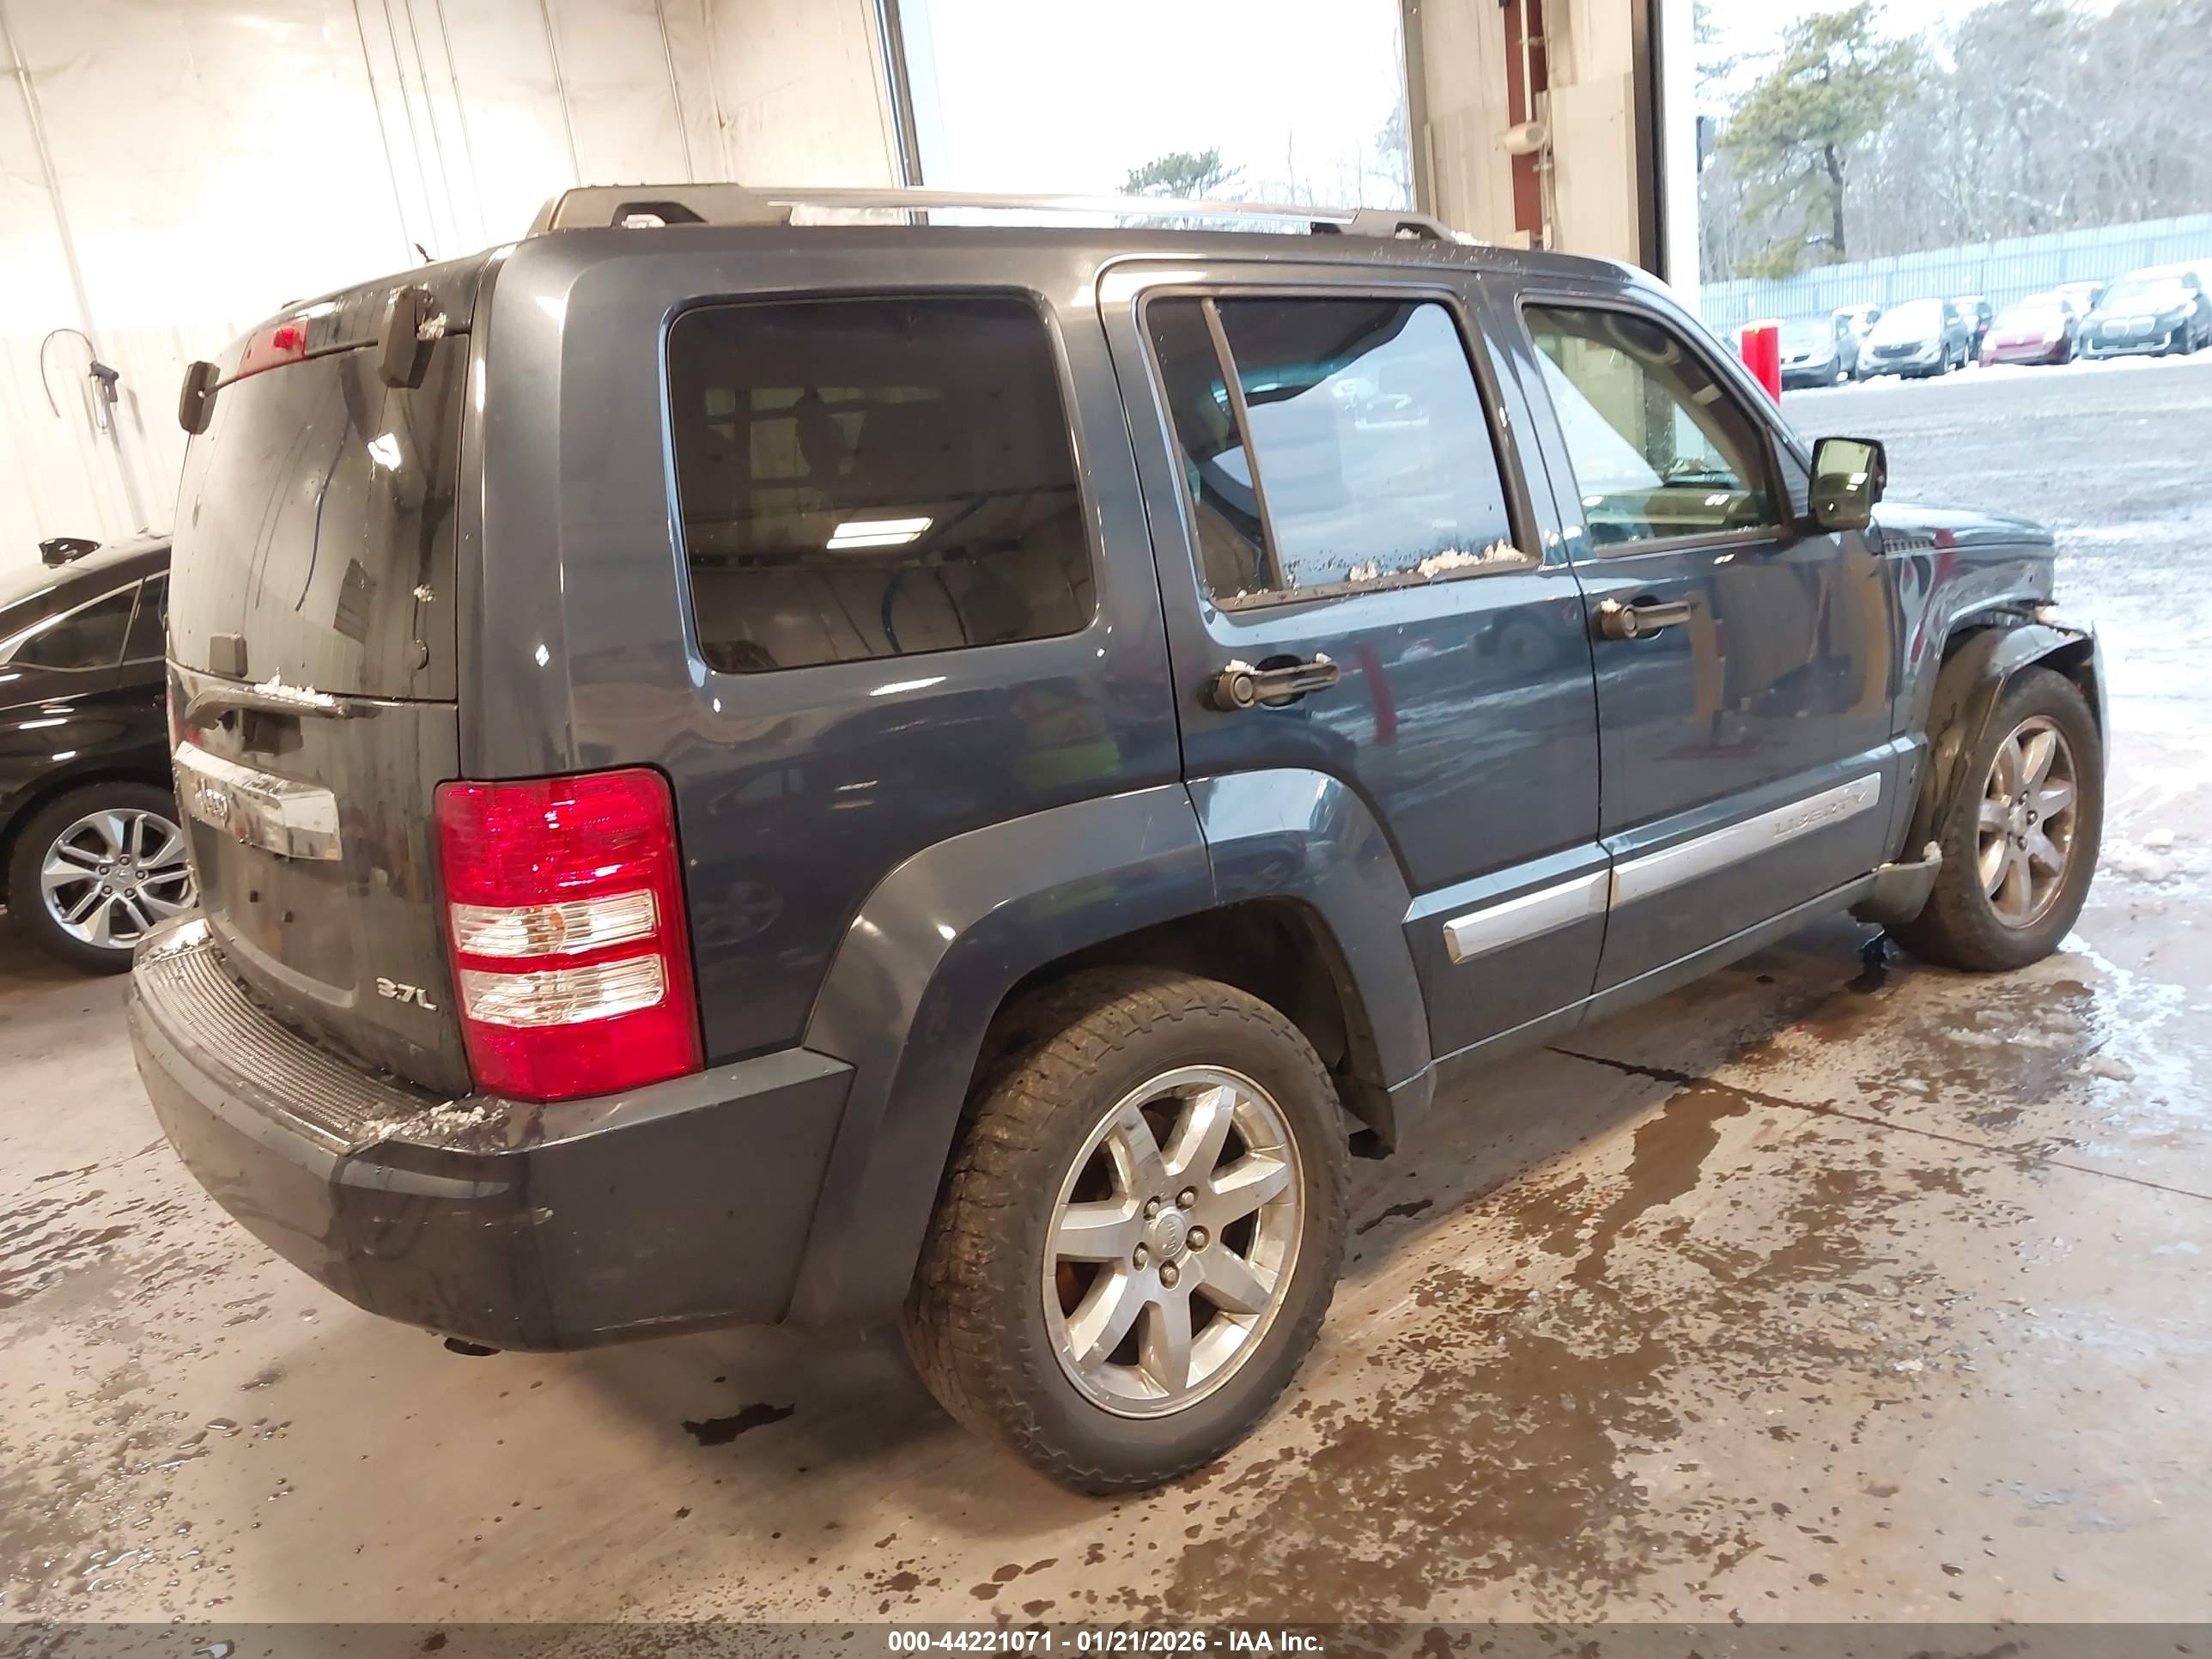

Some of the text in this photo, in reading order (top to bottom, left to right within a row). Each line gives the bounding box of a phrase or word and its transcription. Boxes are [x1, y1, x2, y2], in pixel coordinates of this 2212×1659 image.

[194, 777, 230, 829] Jeep
[1773, 790, 1868, 837] LIBERTY
[376, 975, 438, 1011] 3.7L
